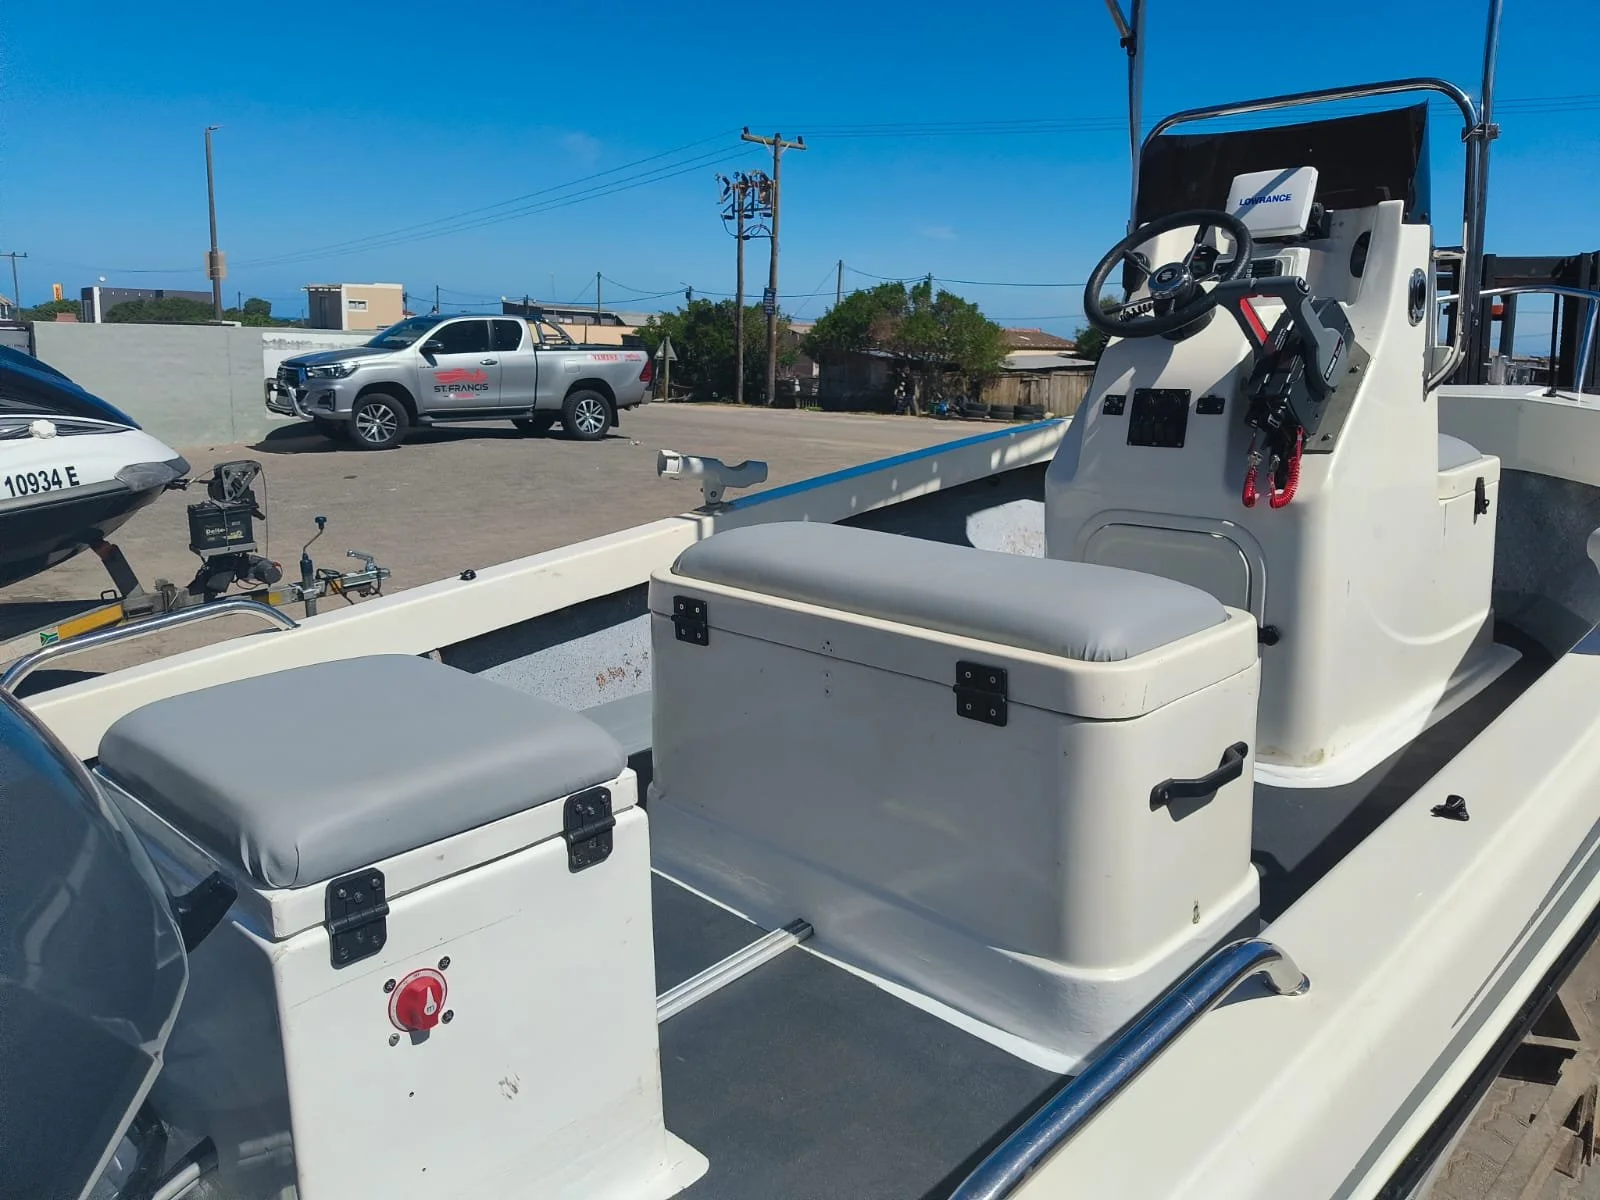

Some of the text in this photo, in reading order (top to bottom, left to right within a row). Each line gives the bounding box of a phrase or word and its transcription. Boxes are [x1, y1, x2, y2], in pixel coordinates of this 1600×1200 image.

[1239, 194, 1292, 206] LOWRANCE
[5, 466, 80, 497] 10934 E
